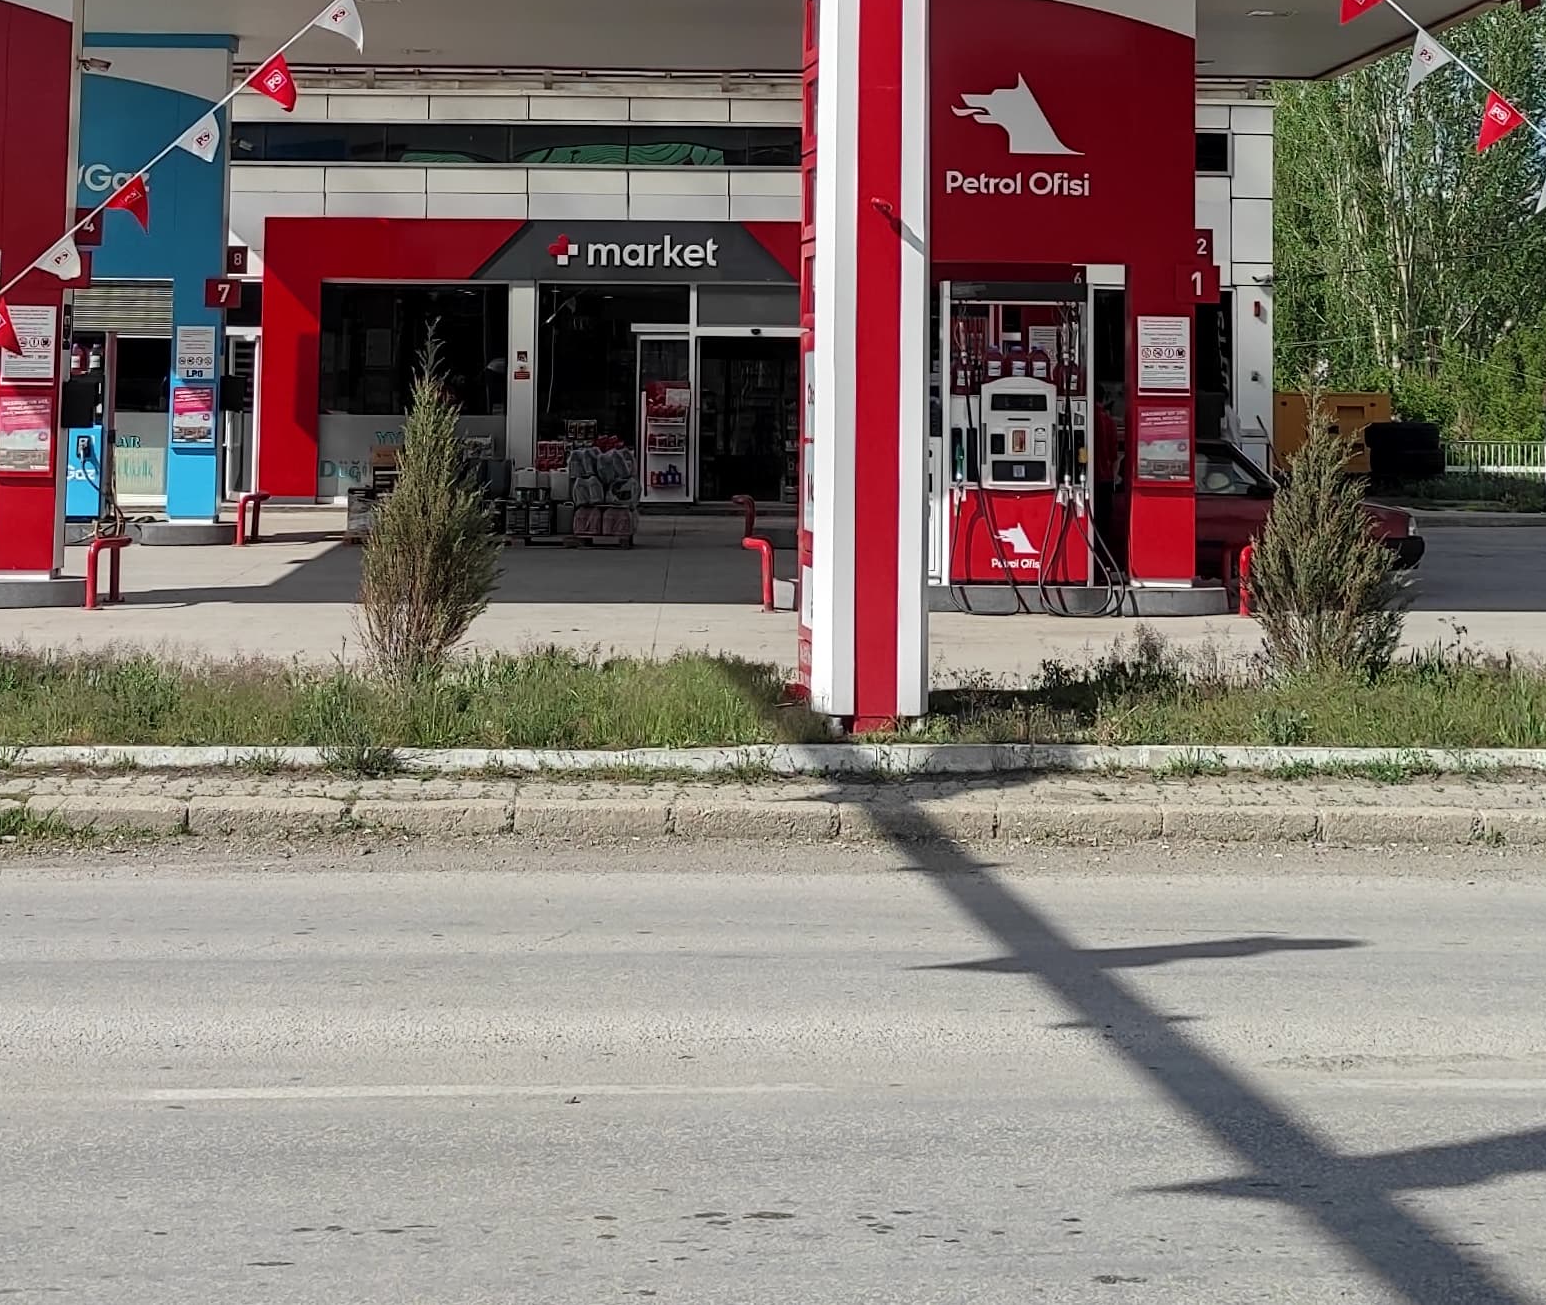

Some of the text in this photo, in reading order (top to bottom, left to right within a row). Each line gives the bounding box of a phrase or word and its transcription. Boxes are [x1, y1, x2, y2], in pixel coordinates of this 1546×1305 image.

[945, 170, 1090, 196] Petrol Ofisi
[83, 217, 95, 233] 4
[587, 235, 719, 267] market
[1196, 238, 1207, 255] 2
[233, 253, 242, 266] 8
[1073, 272, 1082, 284] 6
[1191, 271, 1202, 296] 1
[217, 284, 231, 303] 7
